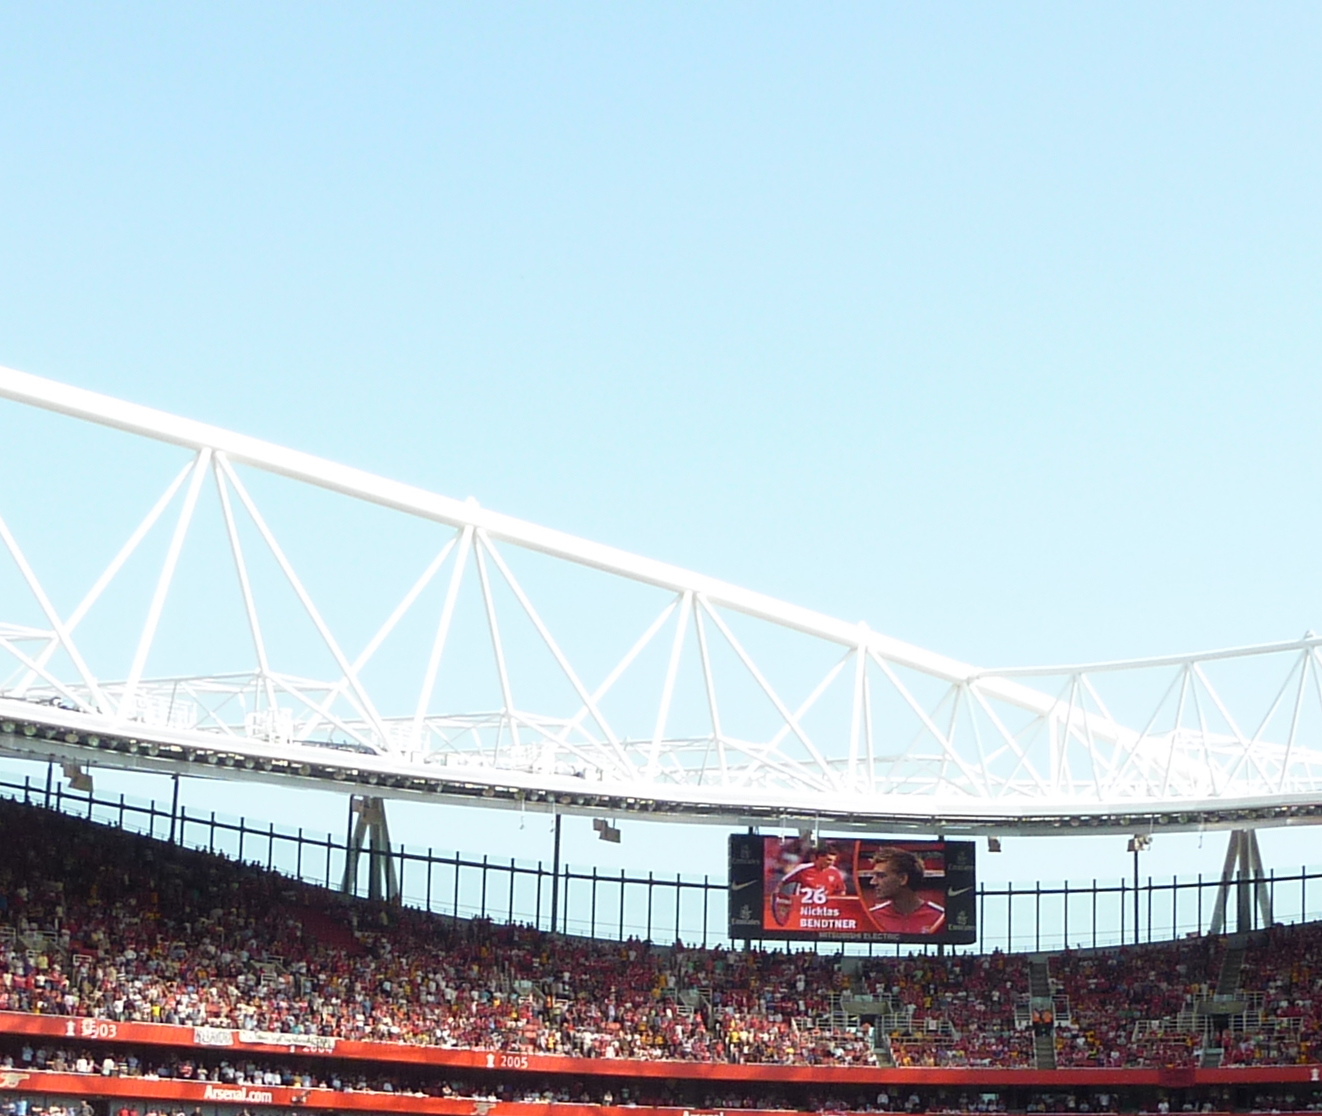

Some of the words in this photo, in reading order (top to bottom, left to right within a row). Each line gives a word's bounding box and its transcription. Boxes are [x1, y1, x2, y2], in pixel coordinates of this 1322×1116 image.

[800, 888, 826, 903] 26
[800, 906, 839, 916] Nicklas
[800, 918, 857, 929] BENDTNER
[863, 933, 900, 941] ELECTRIC
[500, 1055, 528, 1069] 2005
[204, 1085, 272, 1103] Arsenal.com
